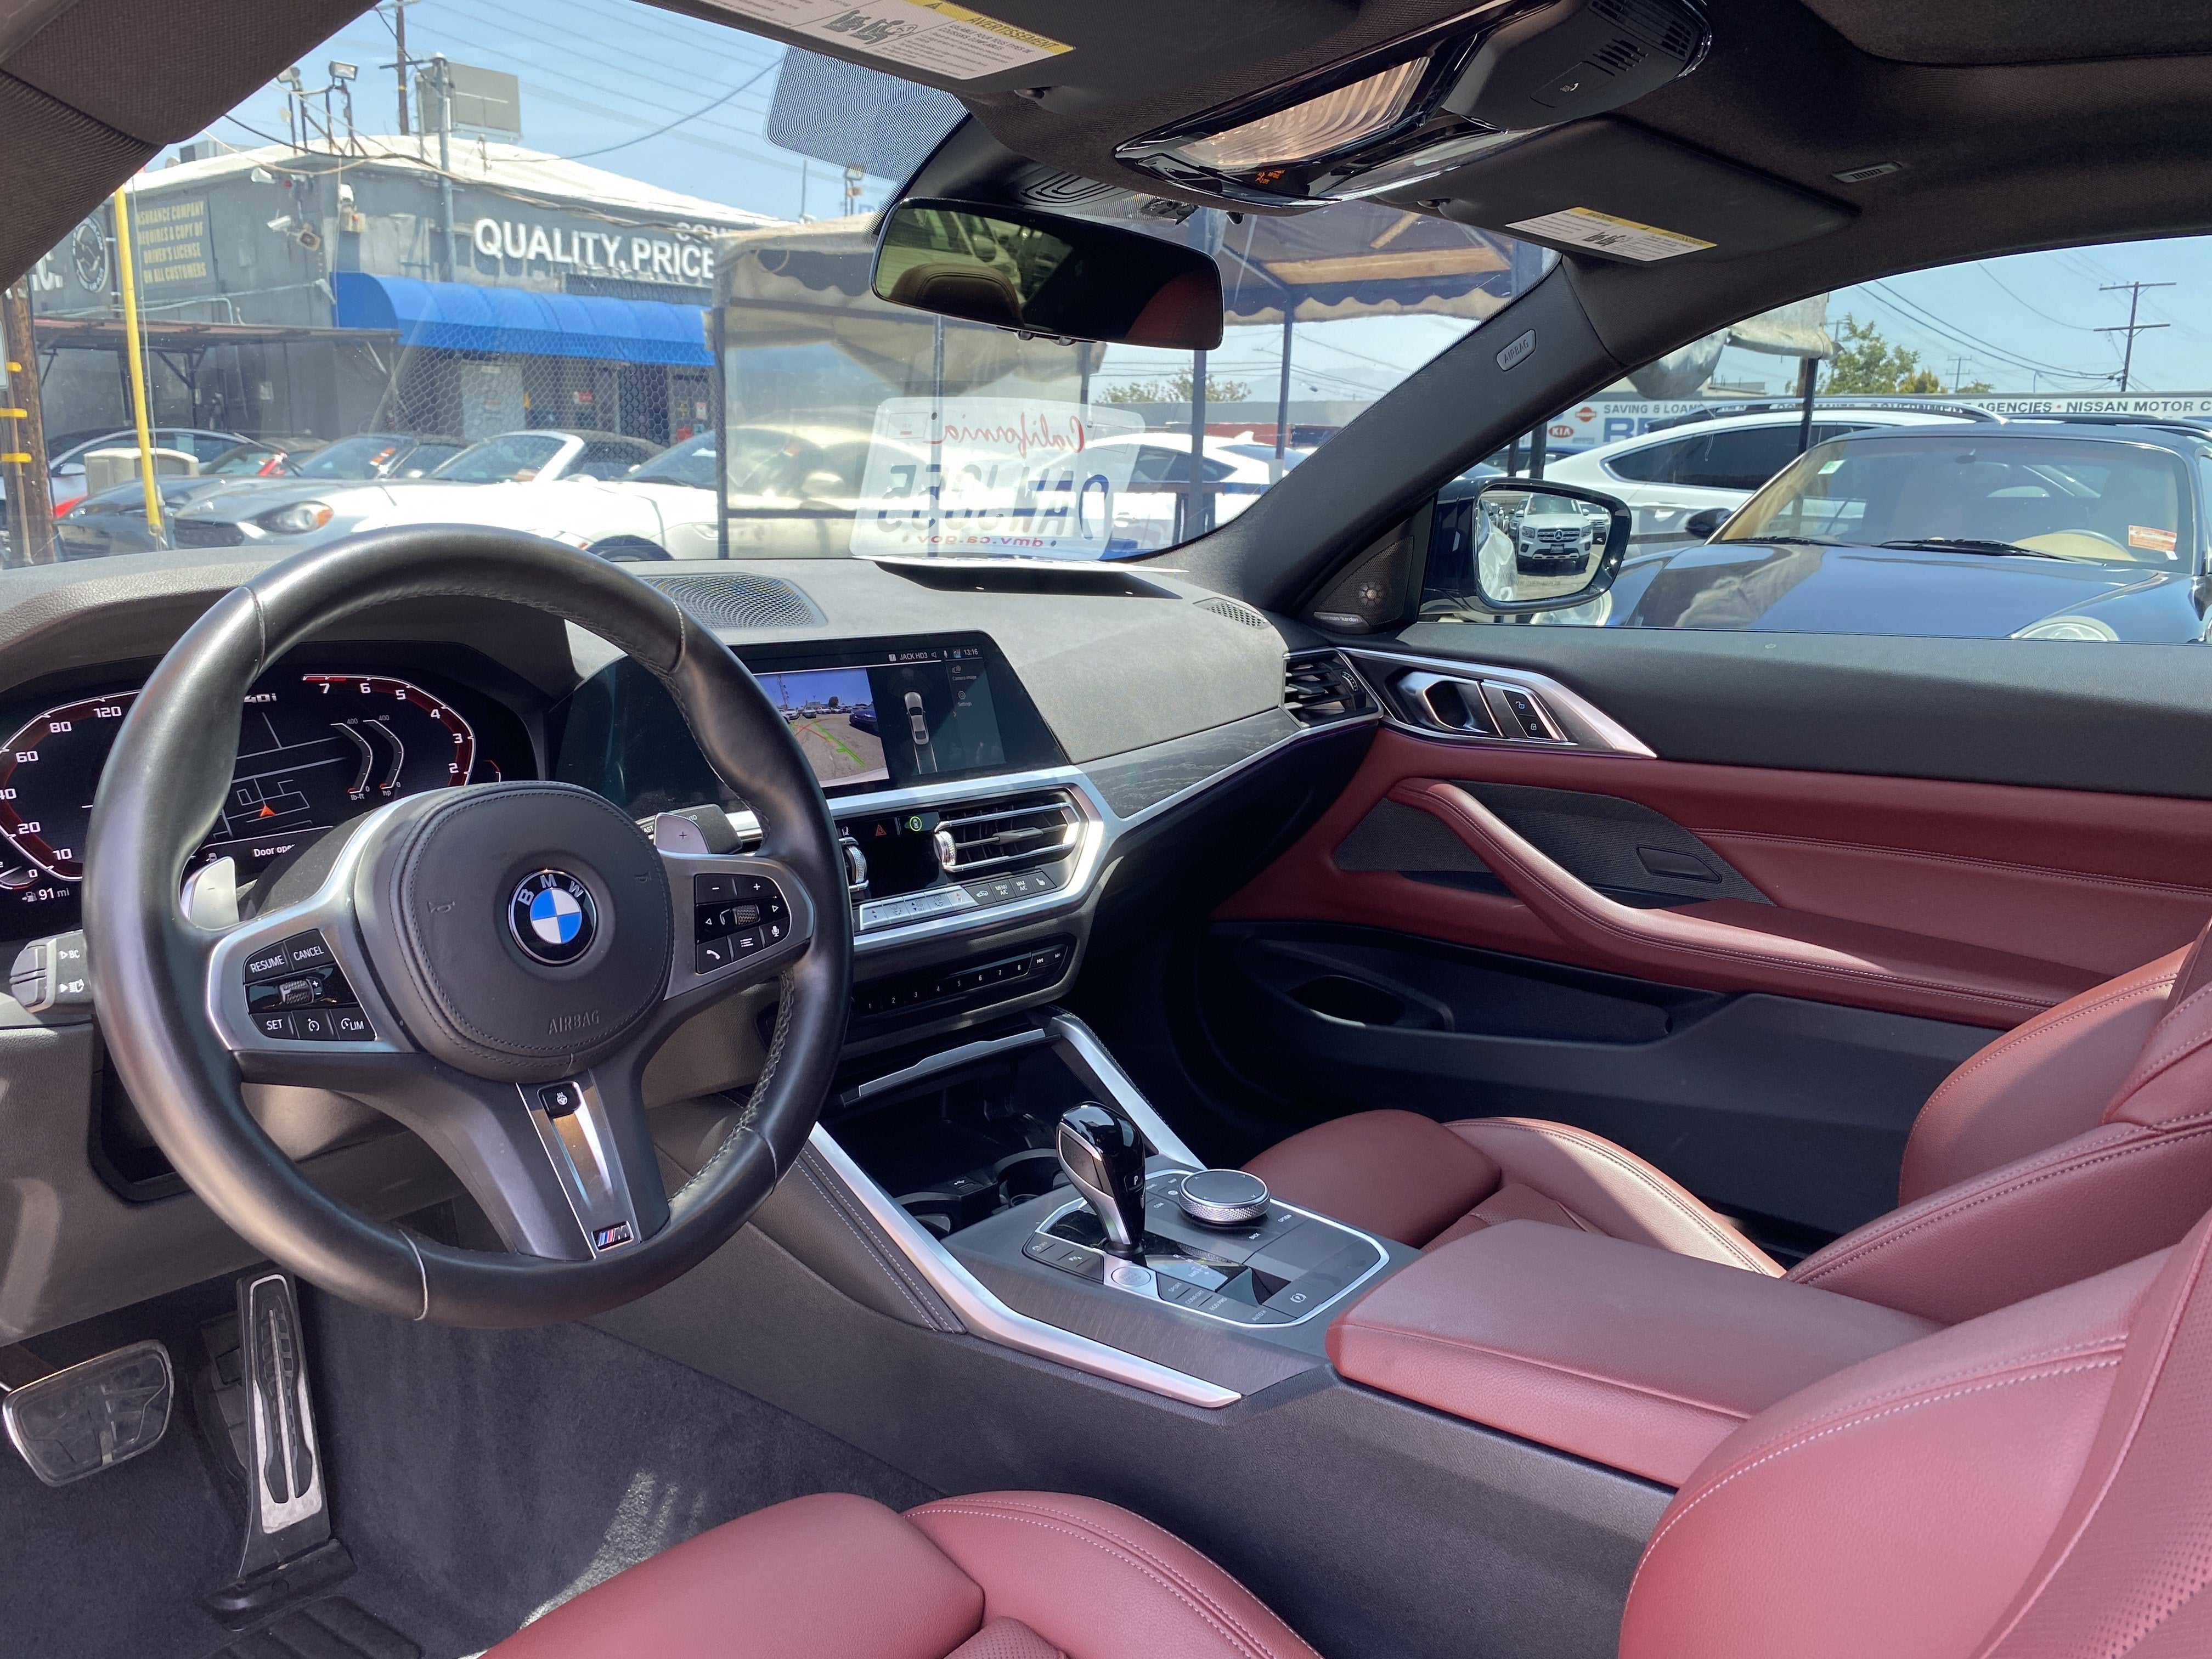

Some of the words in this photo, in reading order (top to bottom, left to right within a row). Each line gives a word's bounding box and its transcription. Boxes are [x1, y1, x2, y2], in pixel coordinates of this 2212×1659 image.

[967, 16, 1059, 50] AVERTISSEMENT
[170, 226, 174, 240] A
[475, 219, 625, 269] QUALITY,
[1504, 340, 1529, 364] AIRBAG
[1604, 404, 1646, 414] SAVING
[1653, 404, 1662, 413] &
[1978, 402, 2051, 413] AGENCIES
[2066, 401, 2128, 414] NISSAN
[2134, 401, 2193, 413] MOTOR
[1552, 427, 1571, 436] KIA
[320, 683, 330, 694] 7
[359, 682, 371, 694] 6
[395, 690, 406, 701] 5
[94, 707, 122, 718] 120
[430, 709, 441, 719] 4
[49, 721, 72, 733] 80
[452, 733, 463, 744] 3
[16, 751, 39, 763] 60
[448, 763, 459, 774] 2
[18, 822, 41, 834] 20
[52, 849, 72, 860] 10
[253, 848, 275, 857] Door
[29, 869, 38, 878] 0
[38, 888, 54, 900] 91
[57, 888, 70, 898] mi
[517, 874, 584, 906] BMW
[69, 950, 80, 958] BC
[294, 945, 325, 961] CANCEL
[250, 955, 285, 973] RESUME
[266, 1019, 283, 1030] SET
[350, 1020, 364, 1031] LIM
[549, 1009, 601, 1035] AIRBAG
[1134, 1176, 1139, 1186] P
[1168, 1282, 1183, 1293] SPORT
[1184, 1290, 1205, 1305] COMFORT
[1209, 1302, 1220, 1311] ECO
